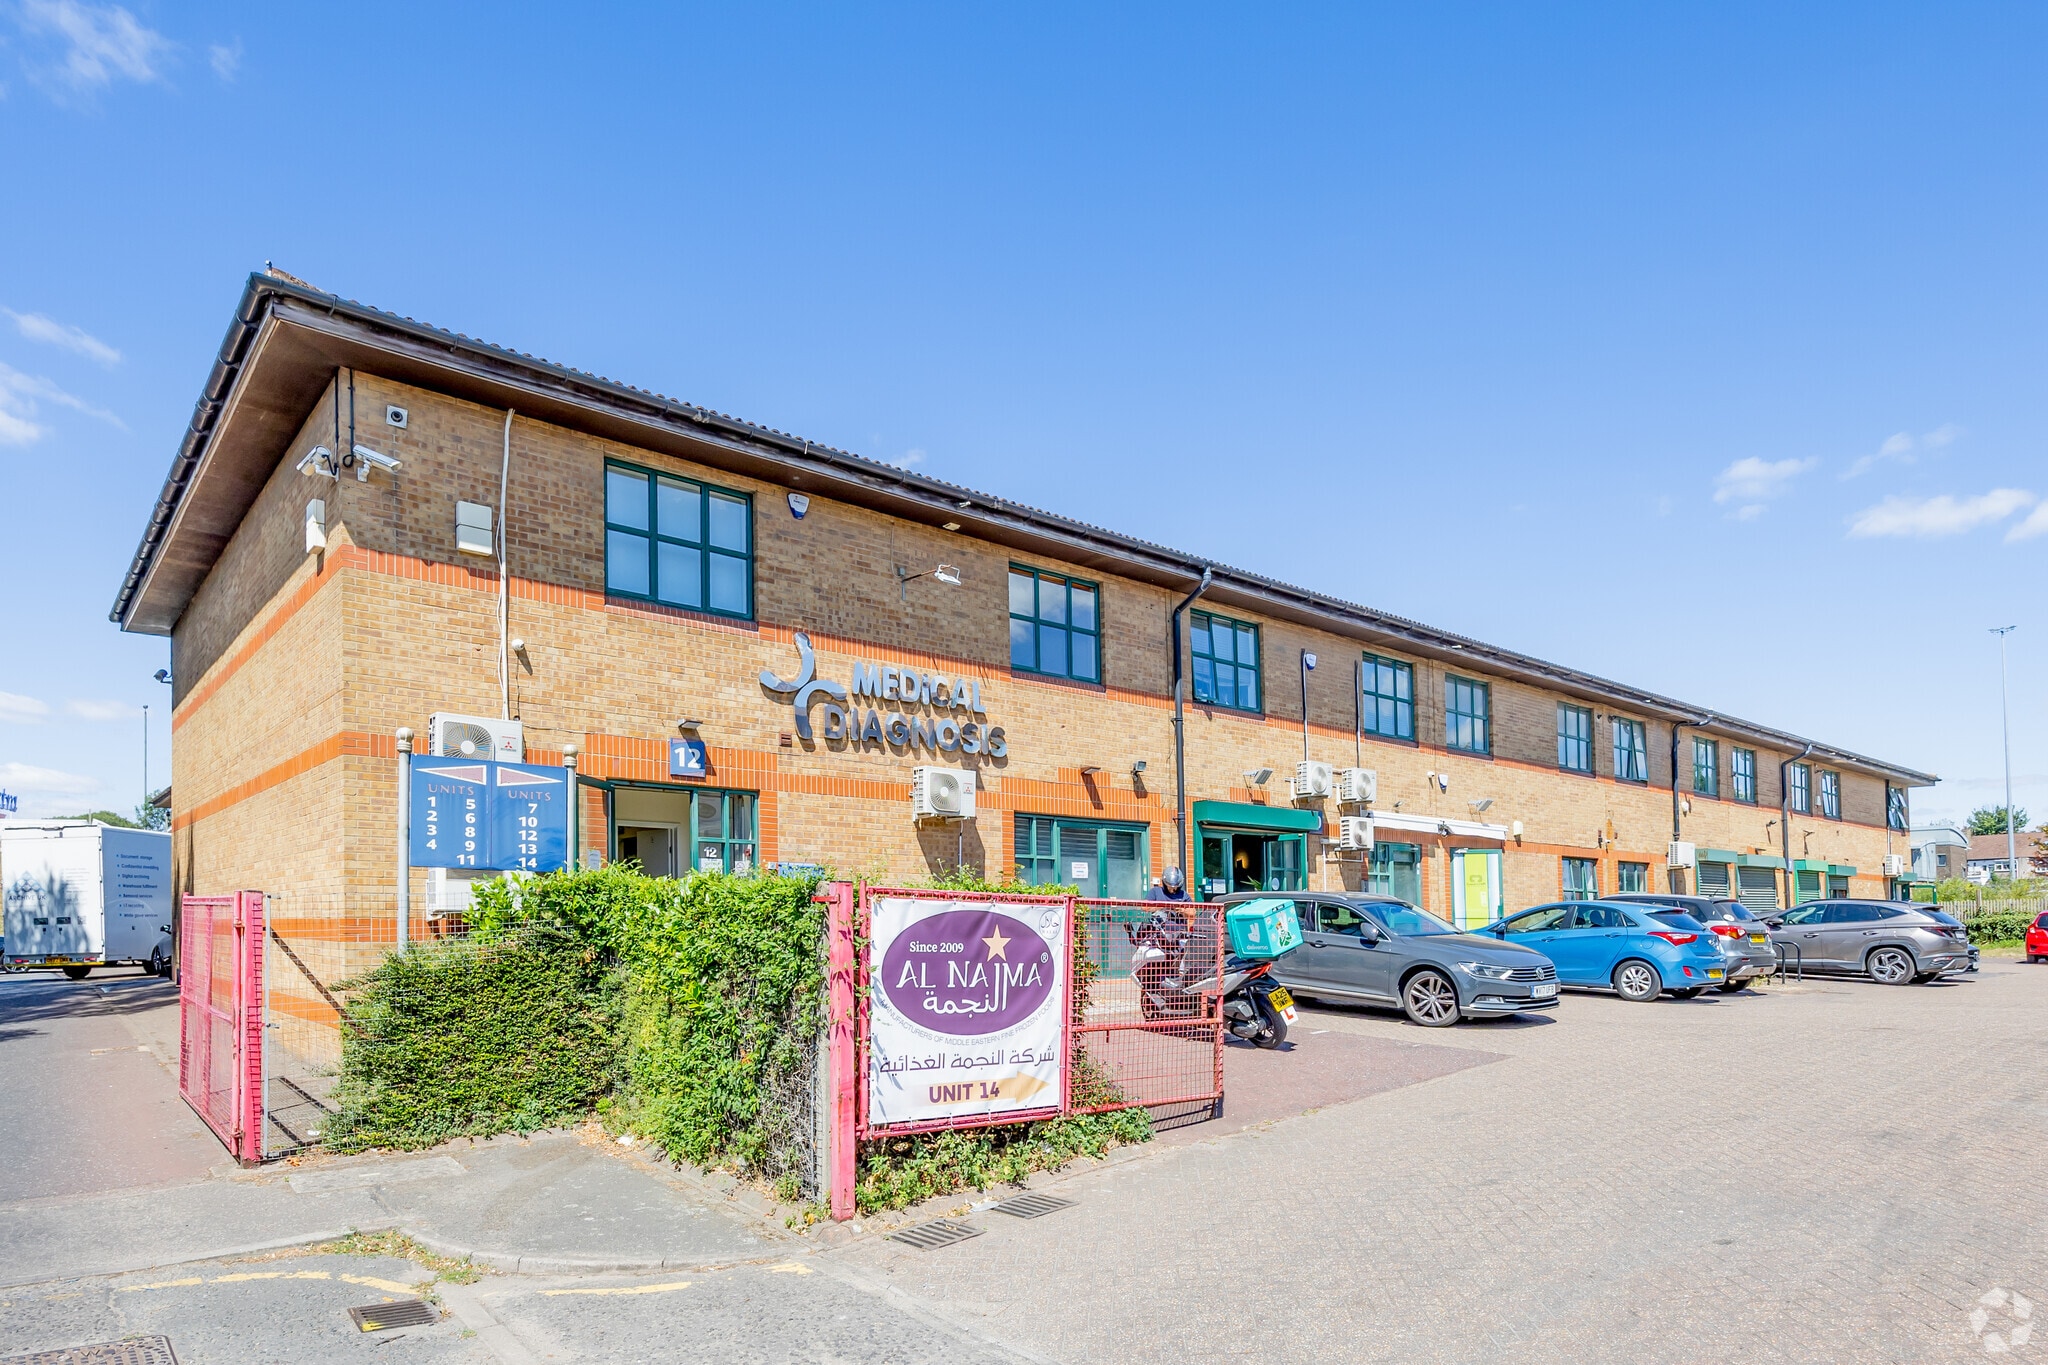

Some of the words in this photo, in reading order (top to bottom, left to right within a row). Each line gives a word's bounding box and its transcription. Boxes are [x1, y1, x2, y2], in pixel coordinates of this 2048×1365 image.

[823, 703, 1008, 758] DIAGNOSIS
[674, 747, 701, 769] 12
[428, 783, 474, 796] UNITS
[508, 789, 551, 801] UNITS
[427, 796, 436, 808] 1
[465, 798, 476, 810] 5
[528, 803, 538, 814] 7
[426, 810, 438, 822] 2
[465, 812, 476, 824] 6
[518, 816, 538, 828] 10
[426, 824, 438, 836] 3
[464, 826, 476, 838] 8
[518, 830, 538, 841] 12
[426, 838, 437, 850] 4
[465, 840, 476, 852] 9
[518, 843, 538, 855] 13
[703, 846, 717, 858] 12
[456, 854, 475, 866] 11
[518, 857, 538, 868] 14
[909, 941, 938, 953] Since
[940, 942, 964, 954] 2009
[896, 960, 937, 989] AL
[922, 977, 1008, 1018] النجمة
[934, 1034, 944, 1044] OF
[945, 1037, 970, 1047] MIDDLE
[971, 1035, 1001, 1047] EASTERN
[1001, 1028, 1015, 1040] FINE
[1015, 1016, 1038, 1034] FROZEN
[1037, 996, 1056, 1017] FOODS
[951, 1049, 1004, 1070] النجمة
[1009, 1045, 1056, 1067] شركة
[879, 1052, 946, 1077] الغذائية
[929, 1082, 974, 1103] UNIT
[979, 1081, 1000, 1099] 14
